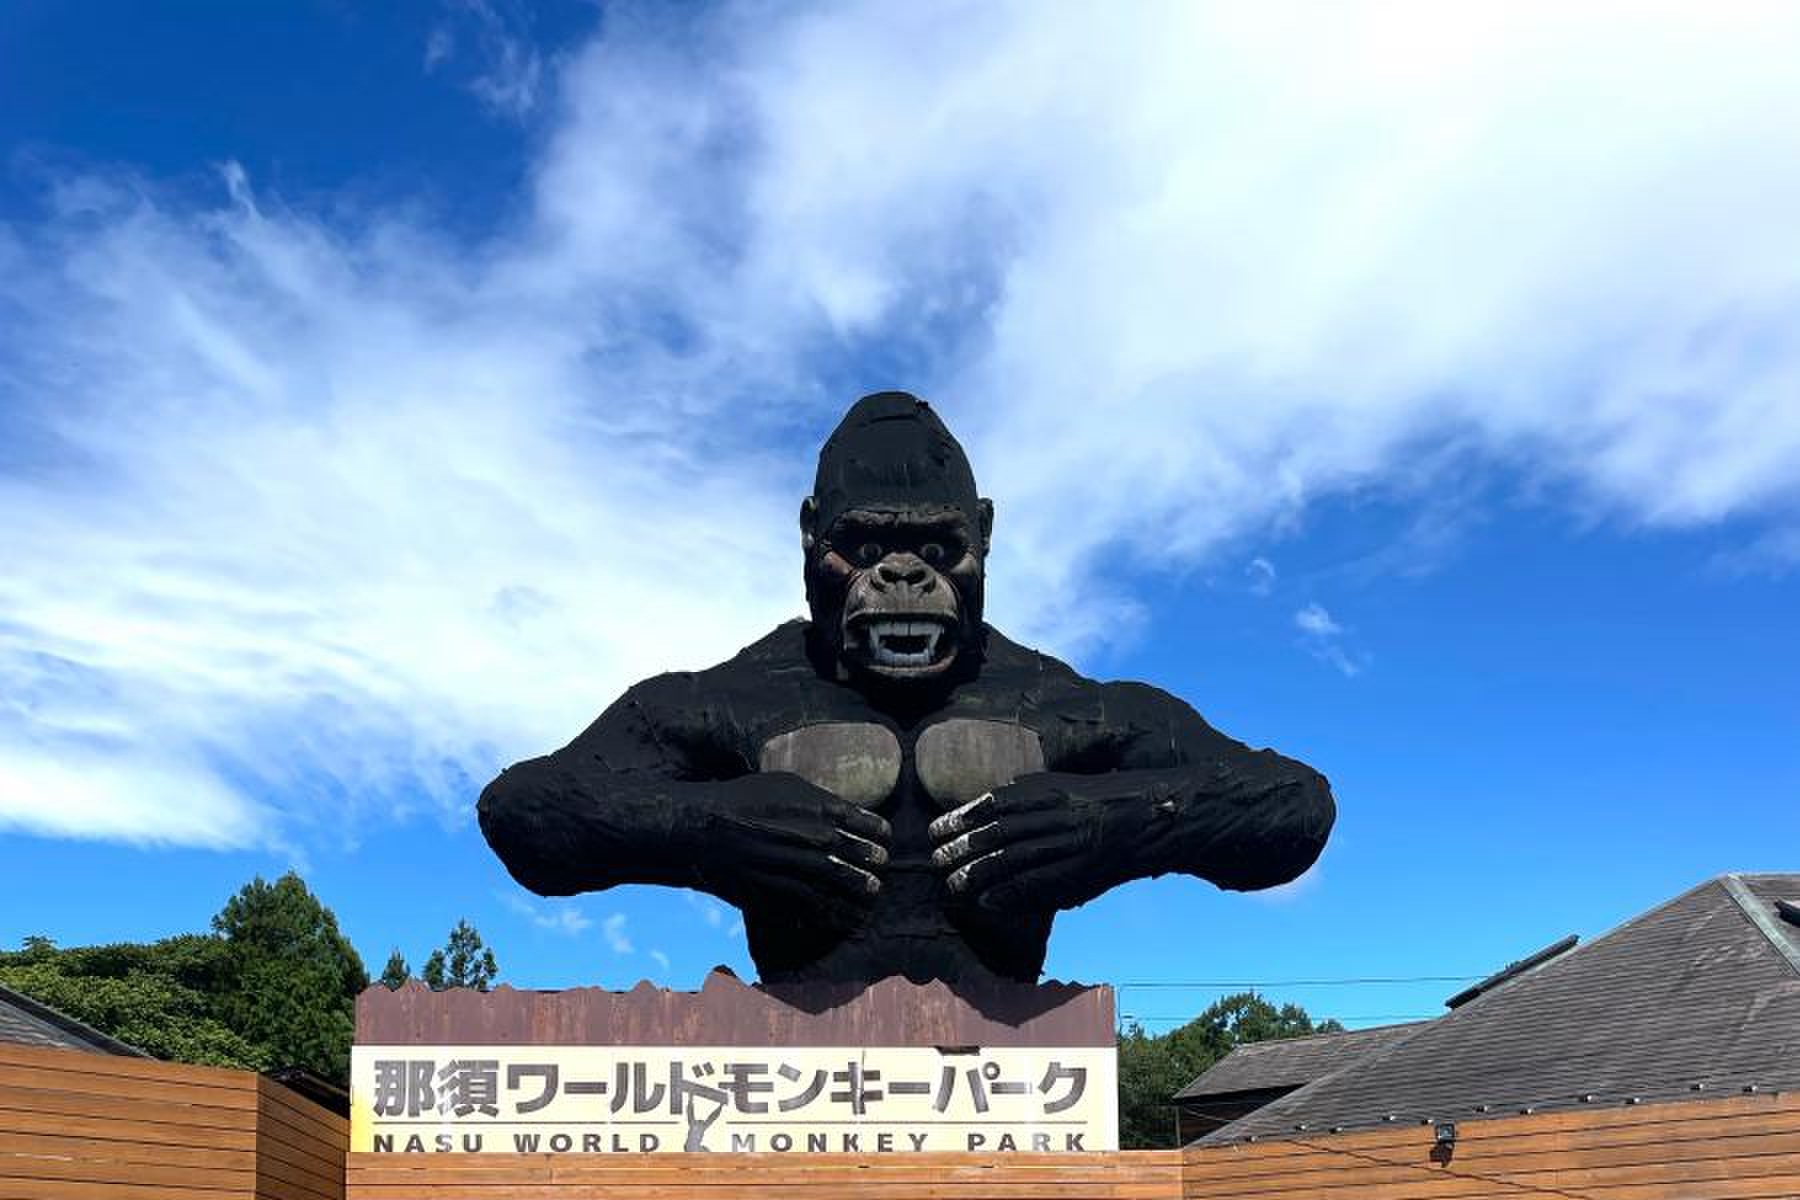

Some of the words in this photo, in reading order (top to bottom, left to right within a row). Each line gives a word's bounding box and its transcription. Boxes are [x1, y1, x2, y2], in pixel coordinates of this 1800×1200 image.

[373, 1059, 1088, 1118] 那須ワールドモンキーパーク
[373, 1132, 484, 1153] NASU
[512, 1132, 661, 1153] WORLD
[731, 1132, 929, 1153] MONKEY
[967, 1132, 1087, 1153] PARK
